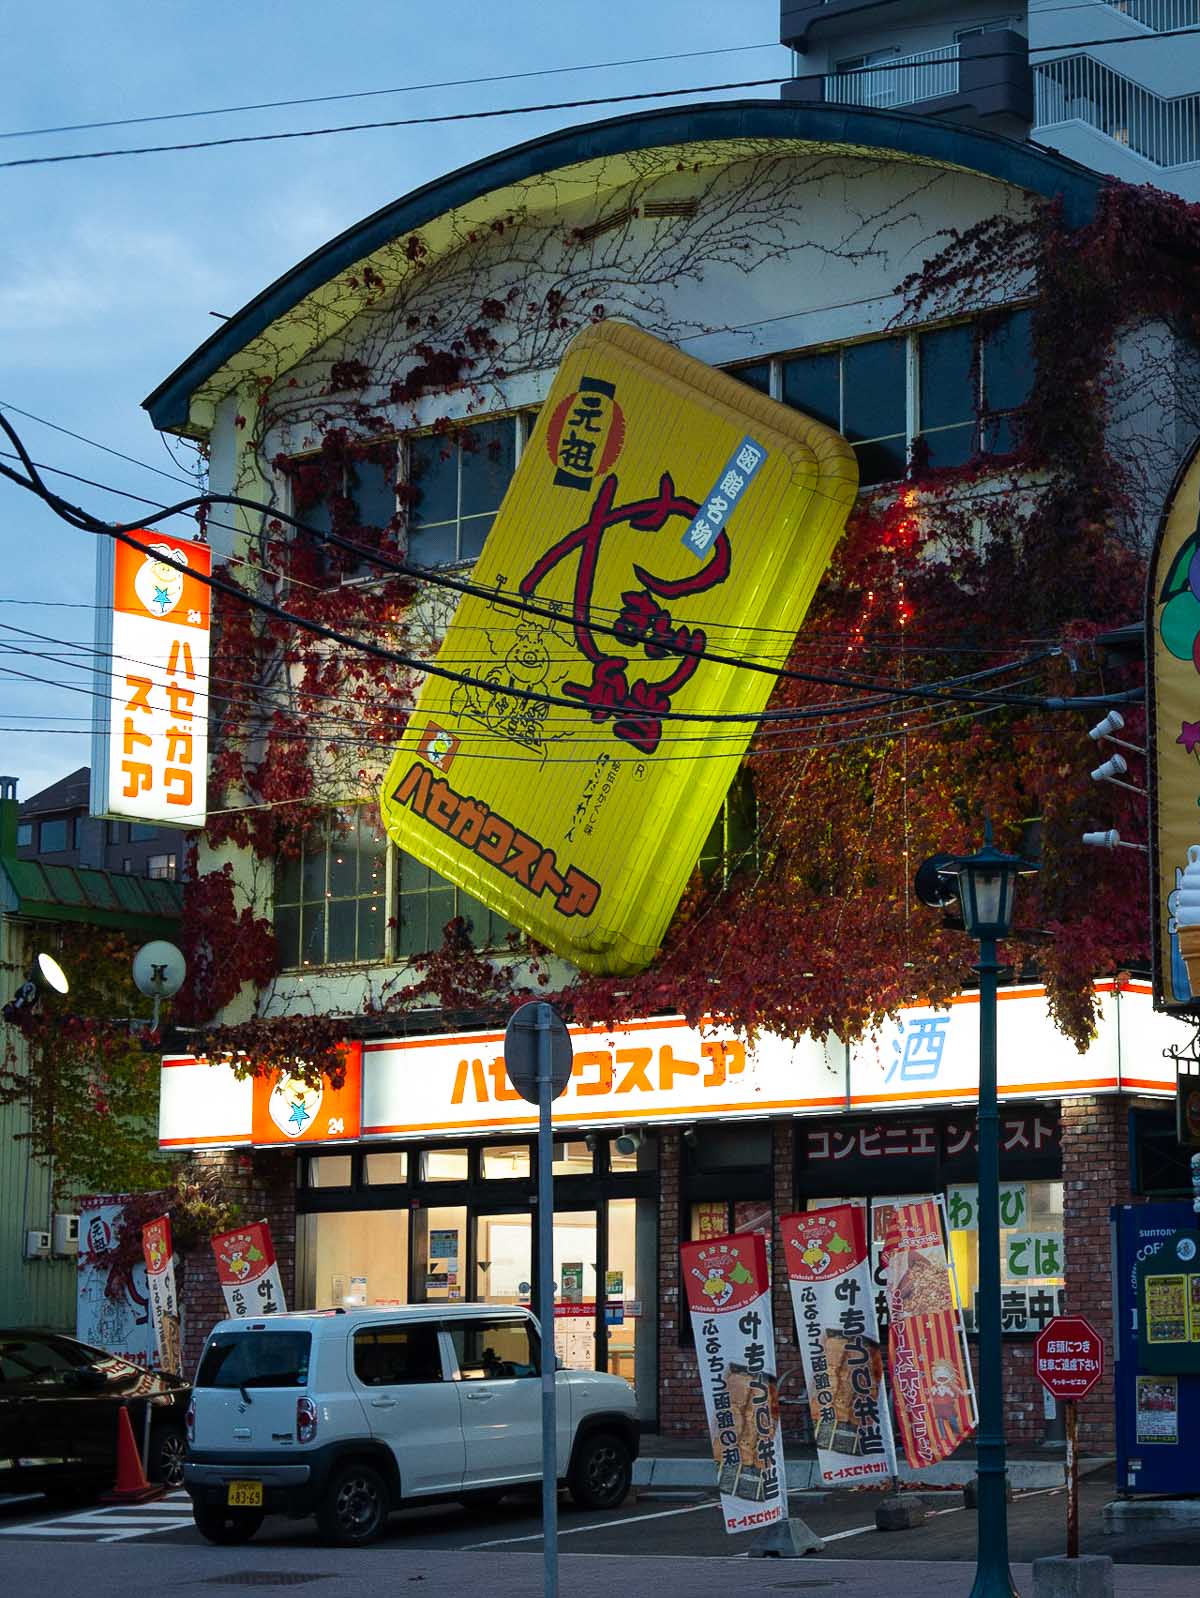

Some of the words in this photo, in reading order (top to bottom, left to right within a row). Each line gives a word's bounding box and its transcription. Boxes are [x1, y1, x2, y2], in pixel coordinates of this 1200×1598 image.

[559, 397, 602, 473] 元祖
[691, 444, 761, 549] 函館名物
[122, 673, 153, 798] ストア
[164, 639, 195, 806] ハセガワ
[392, 762, 601, 917] ハセガワストア
[451, 1041, 746, 1104] ハセワストア
[884, 1016, 951, 1083] 酒
[328, 1118, 344, 1134] 24
[808, 1118, 1053, 1159] コンビニエンスト
[949, 1187, 1025, 1228] わび
[1009, 1238, 1060, 1275] では
[1039, 1358, 1099, 1371] 駐車ご遠慮下さい
[1047, 1340, 1091, 1353] 店頭につき
